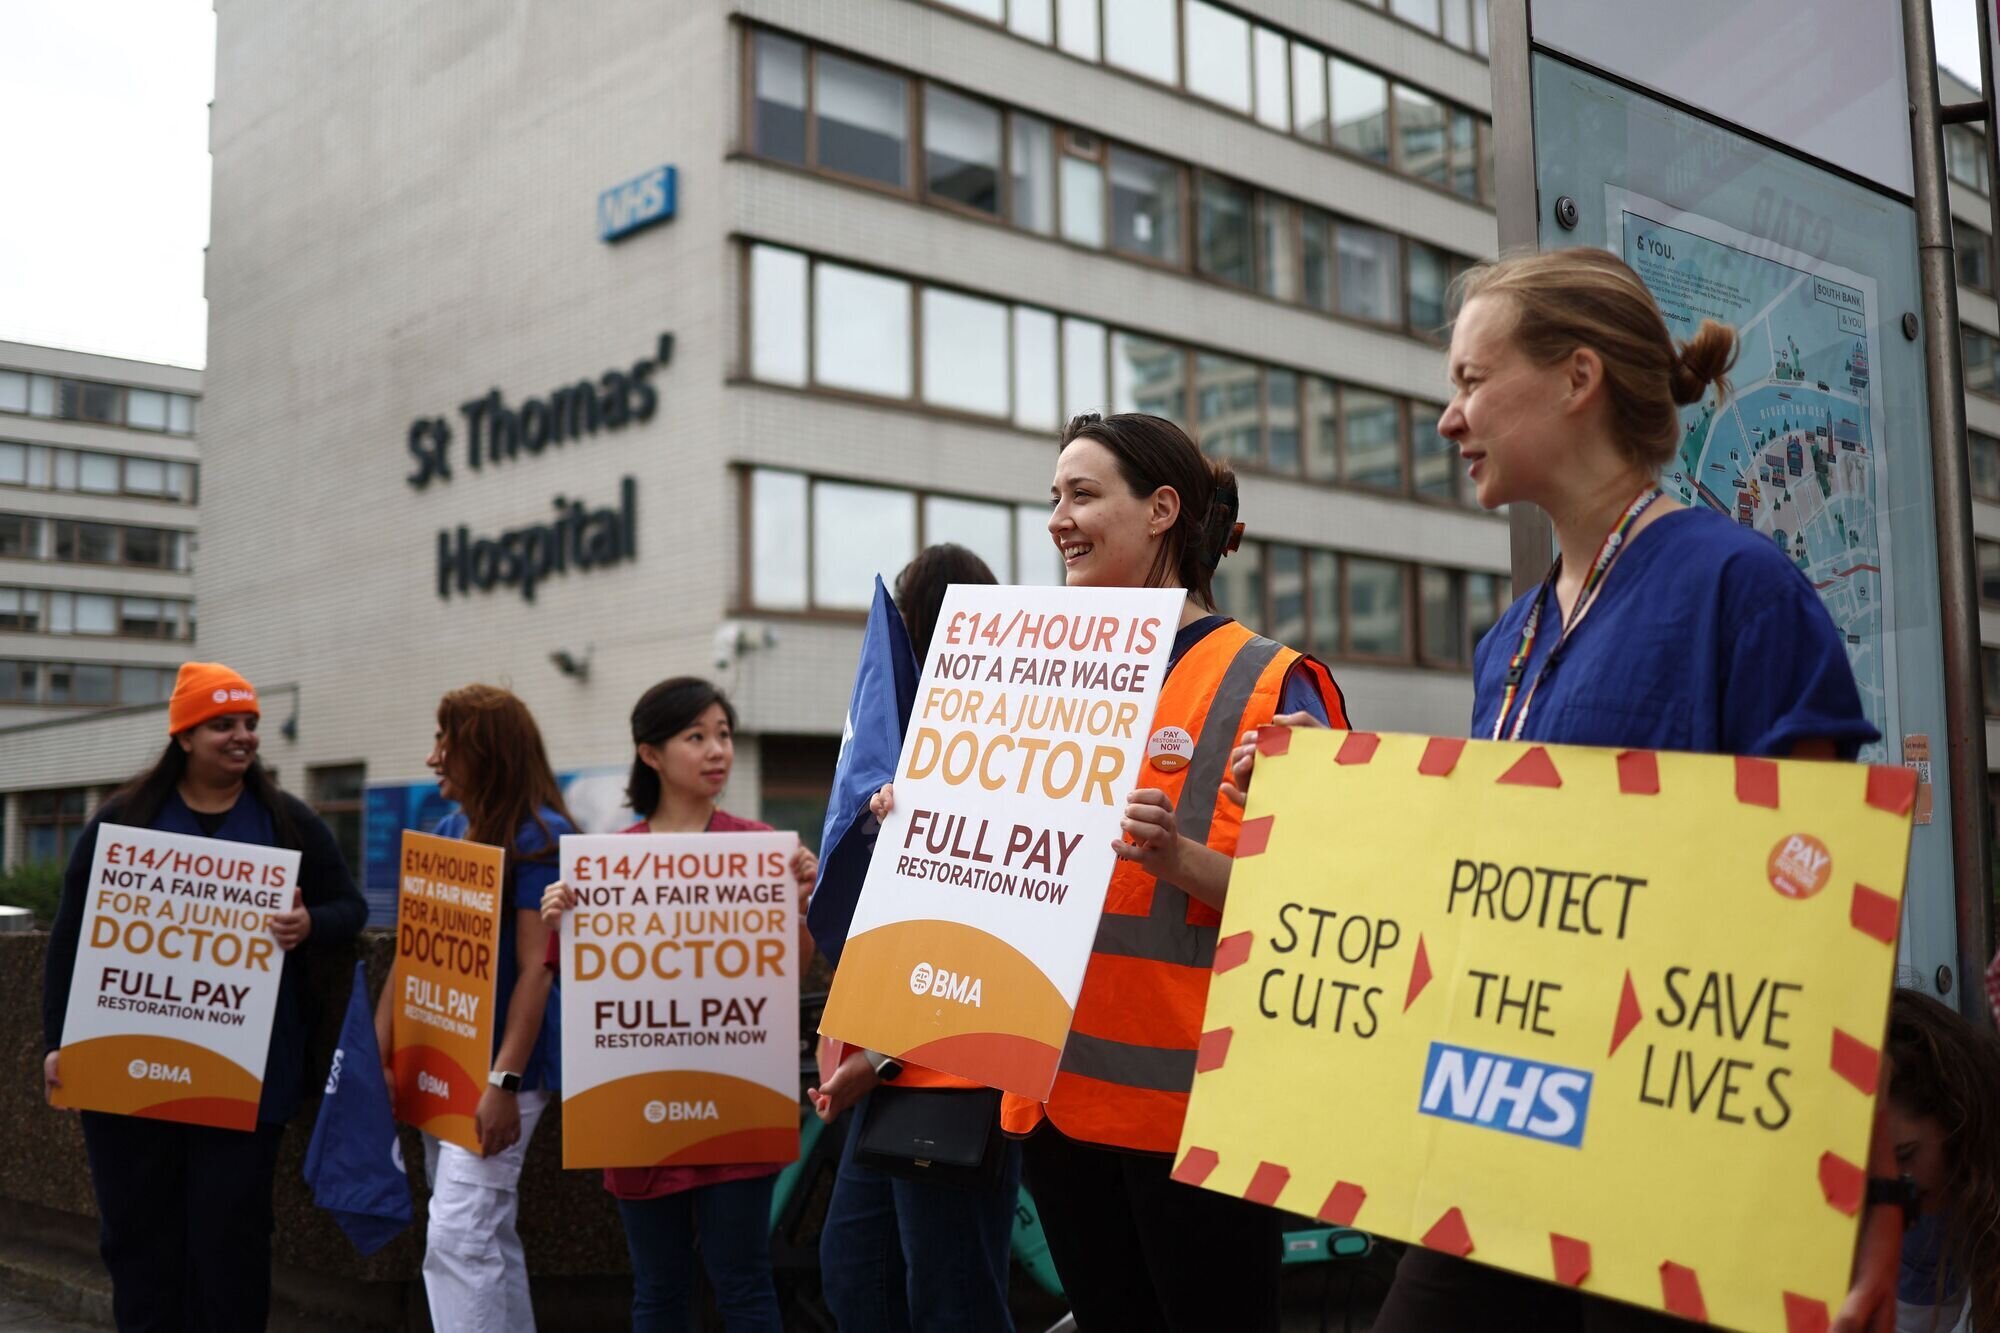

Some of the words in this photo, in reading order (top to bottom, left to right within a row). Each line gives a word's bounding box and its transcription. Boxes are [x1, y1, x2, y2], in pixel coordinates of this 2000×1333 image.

[602, 168, 666, 232] NHS
[1637, 235, 1645, 251] &
[1648, 239, 1675, 260] YOU.
[1817, 284, 1841, 300] SOUTH
[1841, 291, 1861, 308] BANK
[1849, 315, 1862, 329] YOU
[406, 414, 453, 492] St
[460, 330, 676, 472] Thomas'
[436, 474, 638, 605] Hospital
[946, 609, 1120, 654] £14/HOUR
[1124, 618, 1162, 655] IS
[933, 653, 986, 680] NOT
[985, 657, 1004, 682] A
[1008, 658, 1067, 689] FAIR
[1072, 662, 1150, 693] WAGE
[922, 688, 982, 725] FOR
[981, 693, 1008, 727] A
[1011, 695, 1139, 739] JUNIOR
[905, 727, 1127, 806] DOCTOR
[1160, 743, 1181, 751] NOW
[903, 809, 994, 865] FULL
[1002, 824, 1085, 877] PAY
[1781, 835, 1829, 872] PAY
[106, 843, 254, 885] £14/HOUR
[262, 865, 287, 888] IS
[406, 849, 478, 887] £14/HOUR
[482, 865, 495, 888] IS
[573, 853, 748, 881] £14/HOUR
[757, 852, 785, 877] IS
[896, 855, 1018, 897] RESTORATION
[1019, 877, 1069, 906] NOW
[97, 890, 151, 918] FOR
[156, 899, 175, 922] A
[101, 868, 147, 893] NOT
[150, 876, 166, 895] A
[170, 878, 217, 901] FAIR
[222, 886, 283, 910] WAGE
[404, 875, 424, 896] NOT
[425, 880, 435, 898] A
[436, 883, 462, 904] FAIR
[463, 888, 493, 913] WAGE
[573, 887, 626, 907] NOT
[632, 887, 650, 905] A
[655, 886, 708, 904] FAIR
[715, 883, 785, 904] WAGE
[1446, 858, 1648, 940] PROTECT
[402, 898, 428, 925] FOR
[430, 906, 440, 927] A
[440, 907, 492, 941] JUNIOR
[573, 912, 634, 937] FOR
[644, 912, 666, 935] A
[673, 909, 786, 939] JUNIOR
[1268, 902, 1401, 969] STOP
[90, 915, 274, 973] DOCTOR
[401, 924, 490, 981] DOCTOR
[573, 939, 786, 982] DOCTOR
[100, 967, 182, 1003] FULL
[192, 980, 251, 1010] PAY
[405, 976, 446, 1009] FULL
[448, 989, 479, 1023] PAY
[930, 969, 982, 1008] BMA
[1257, 968, 1384, 1040] CUTS
[1467, 968, 1563, 1037] THE
[1655, 965, 1803, 1050] SAVE
[97, 995, 205, 1021] RESTORATION
[208, 1008, 246, 1026] NOW
[404, 1004, 456, 1034] RESTORATION
[456, 1021, 478, 1040] NOW
[595, 1000, 689, 1030] FULL
[702, 998, 768, 1027] PAY
[595, 1031, 719, 1049] RESTORATION
[724, 1030, 767, 1045] NOW
[148, 1062, 191, 1084] BMA
[428, 1076, 450, 1099] BMA
[1421, 1049, 1586, 1139] NHS
[1638, 1043, 1793, 1132] LIVES
[669, 1101, 719, 1121] BMA
